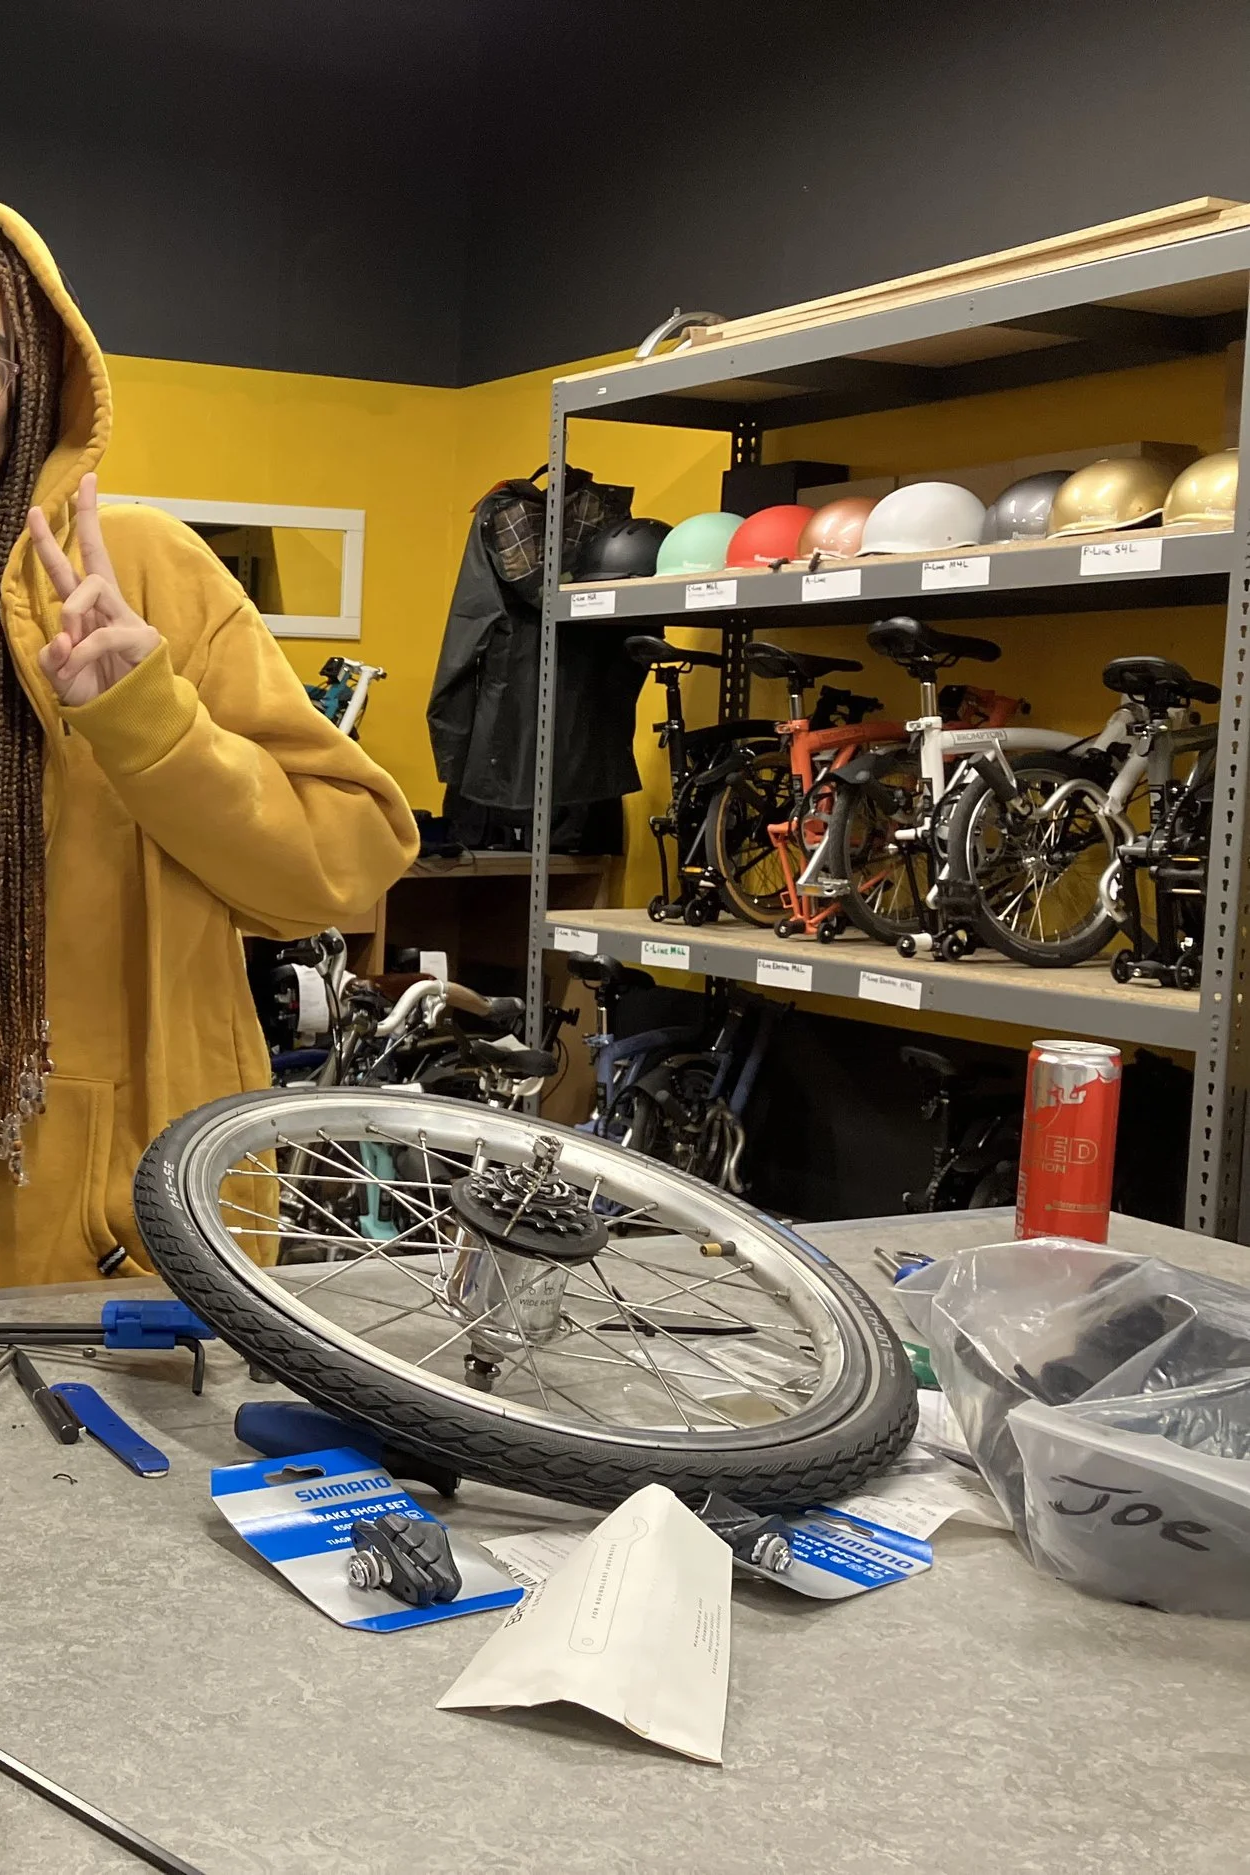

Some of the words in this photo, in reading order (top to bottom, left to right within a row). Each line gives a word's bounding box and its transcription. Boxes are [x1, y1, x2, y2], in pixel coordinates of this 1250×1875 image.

[163, 1160, 184, 1211] 35-349
[827, 1266, 892, 1349] MARATHON
[295, 1476, 392, 1502] SHIMANO
[350, 1504, 387, 1518] SHOE
[388, 1500, 409, 1511] SET
[1048, 1474, 1212, 1551] Joe
[326, 1537, 352, 1546] TIAGR
[806, 1524, 915, 1569] SHIMANO
[825, 1545, 865, 1564] SHOE
[866, 1562, 895, 1576] SET
